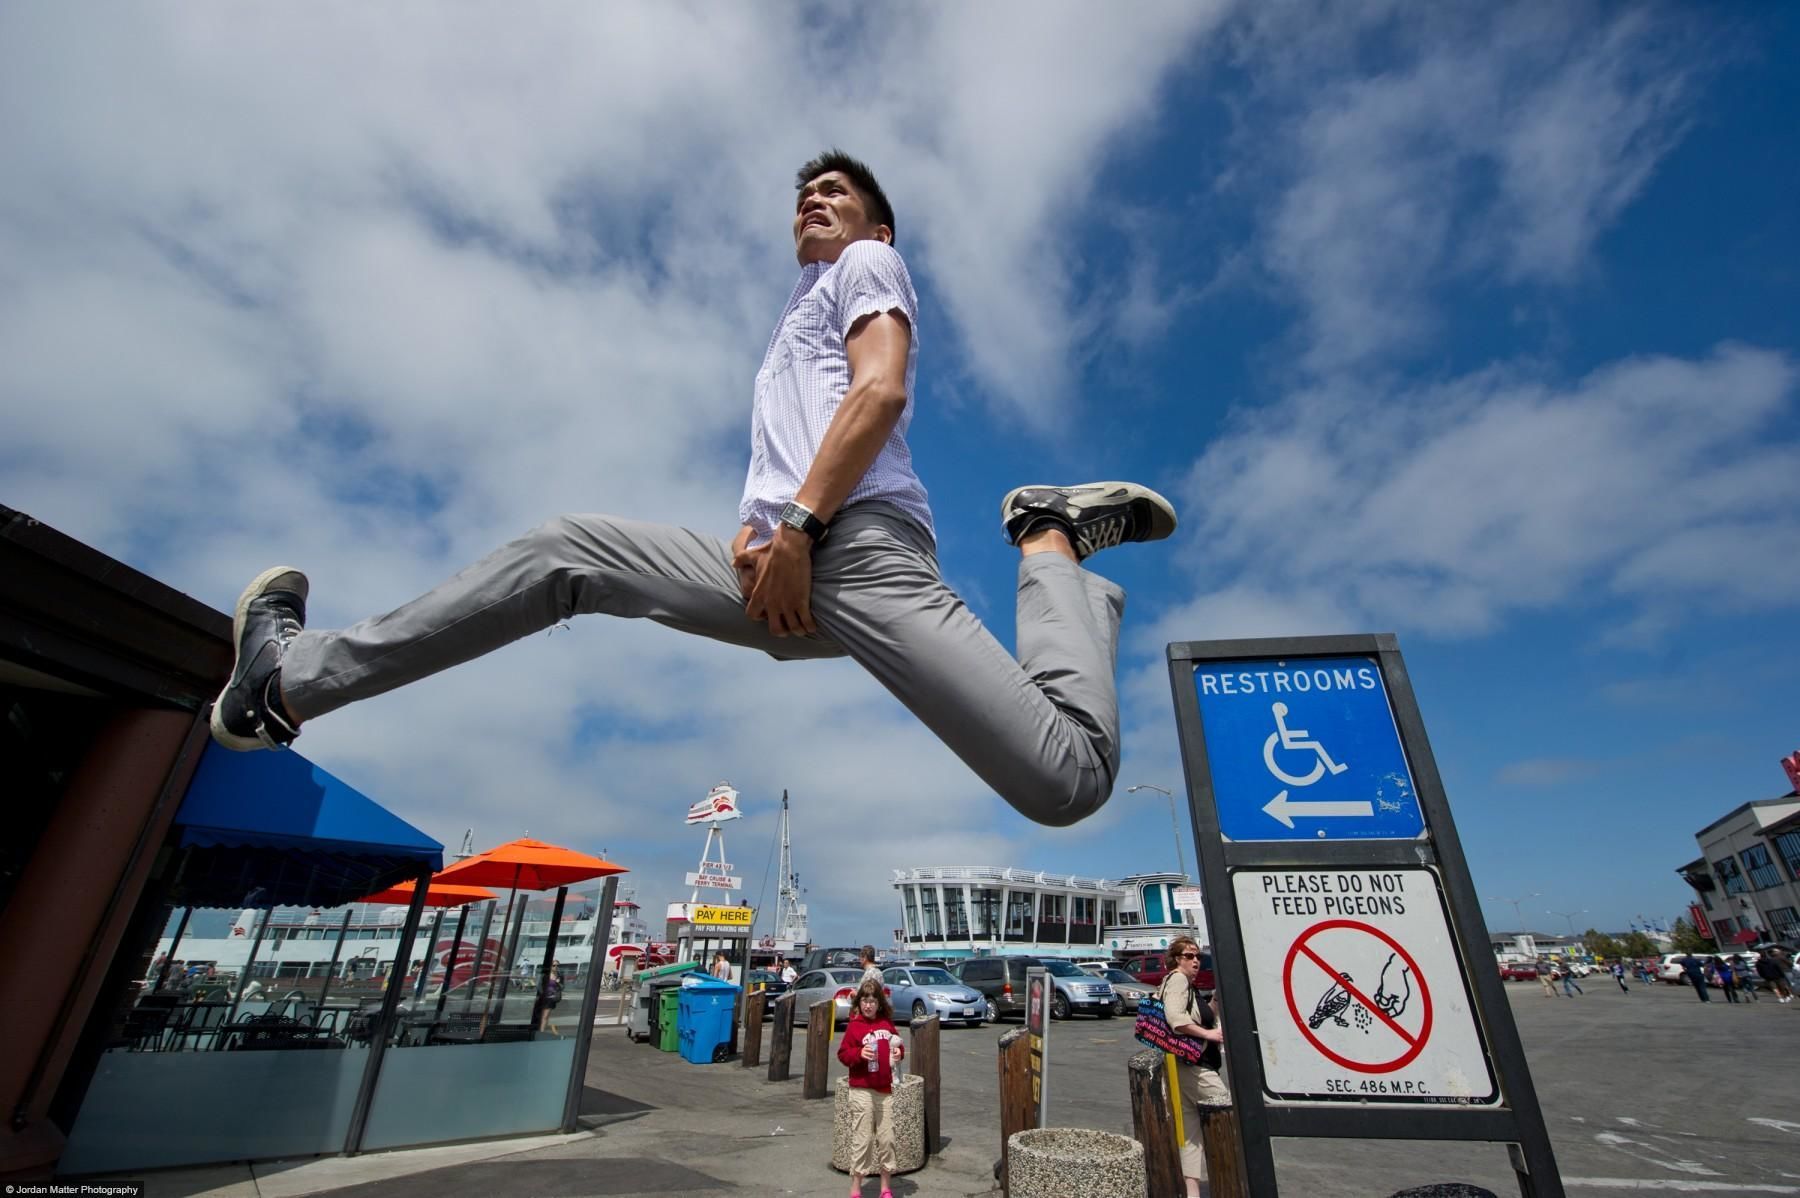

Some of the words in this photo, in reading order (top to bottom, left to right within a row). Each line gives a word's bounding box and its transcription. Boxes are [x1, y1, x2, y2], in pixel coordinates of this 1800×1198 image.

[1201, 668, 1376, 695] RESTROOMS
[1262, 875, 1332, 894] PLEASE
[1337, 874, 1362, 893] DO
[1369, 874, 1405, 893] NOT
[1271, 897, 1318, 915] FEED
[1323, 896, 1406, 915] PIGEONS
[696, 910, 716, 920] PAY
[720, 911, 749, 921] HERE
[1326, 1079, 1356, 1093] SEC.
[1360, 1079, 1387, 1093] 486
